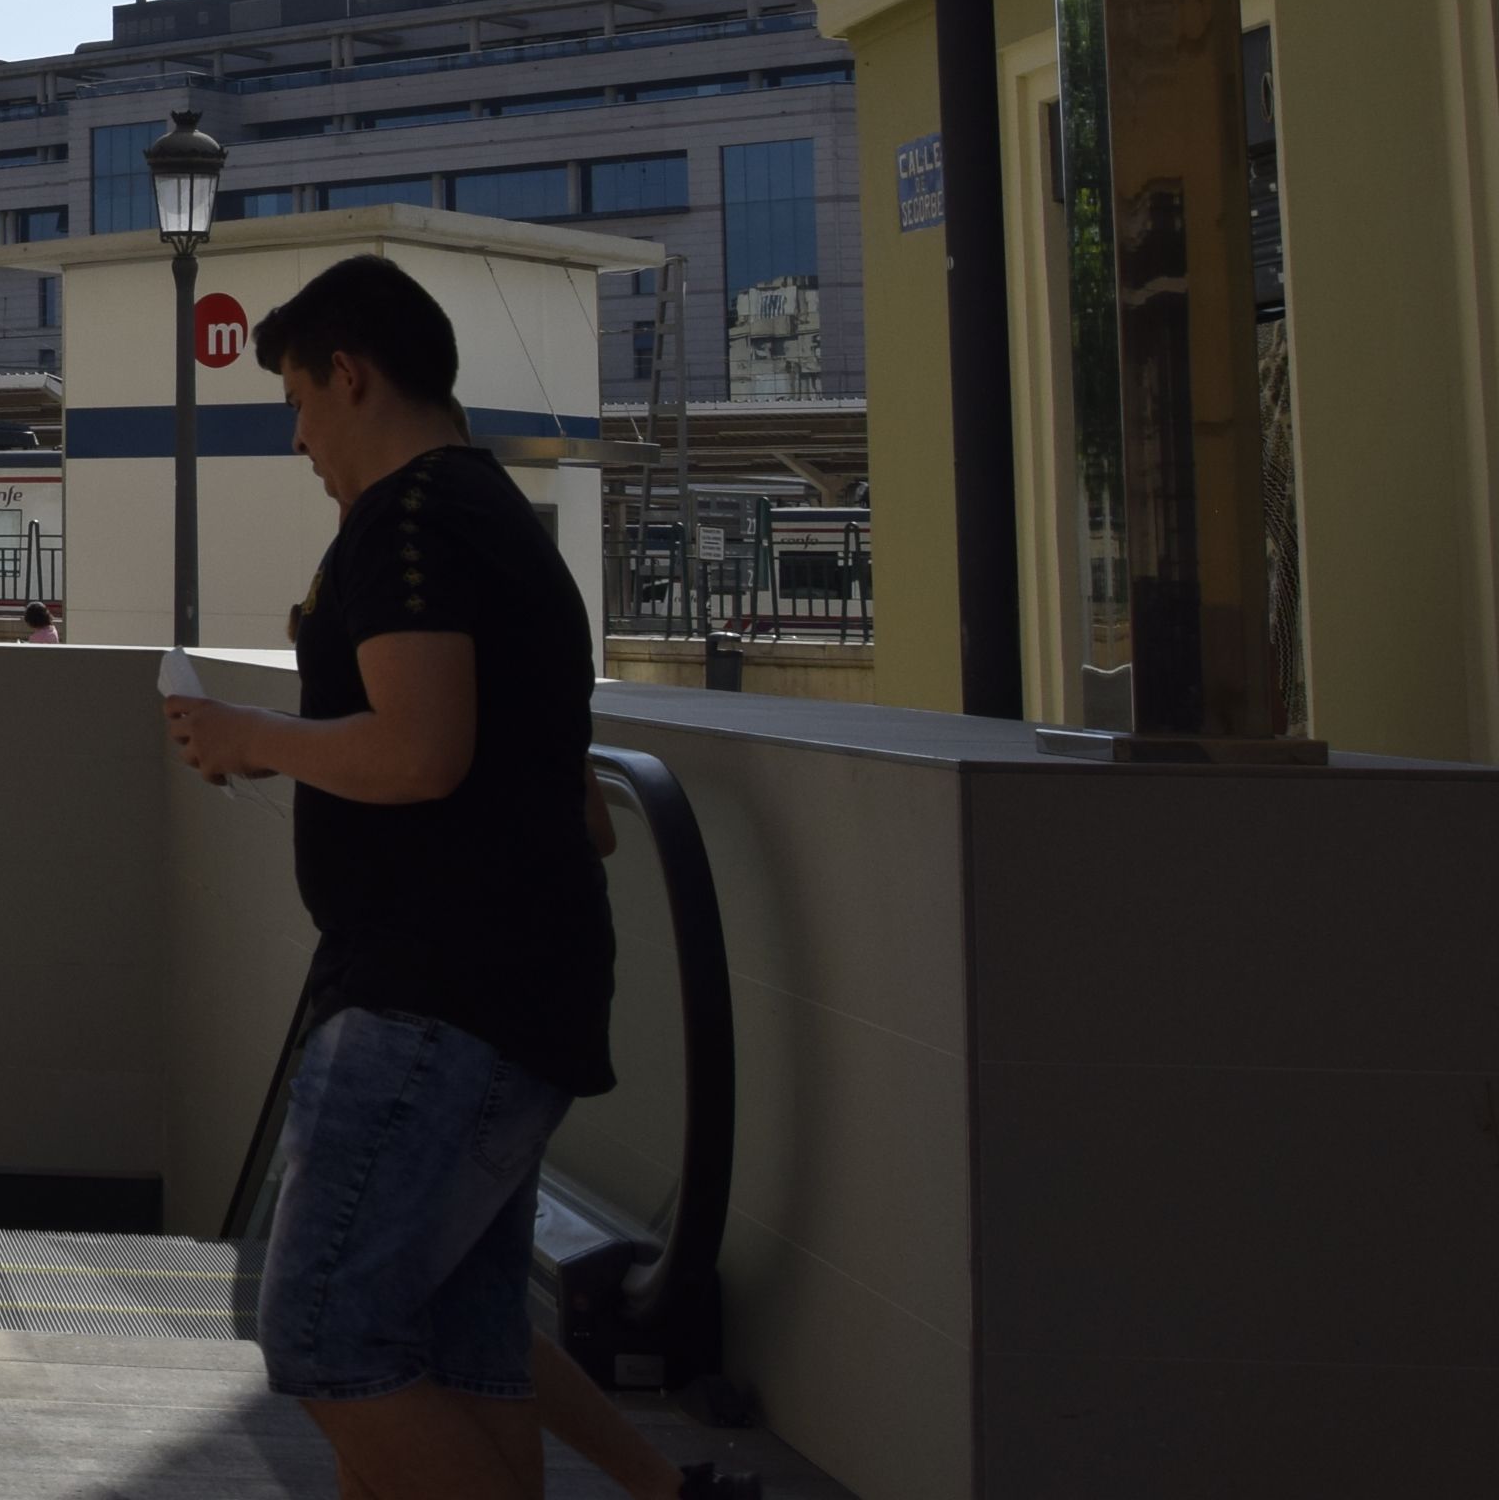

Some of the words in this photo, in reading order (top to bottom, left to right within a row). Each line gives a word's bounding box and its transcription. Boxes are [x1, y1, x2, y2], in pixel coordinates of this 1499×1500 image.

[899, 142, 942, 179] CALLE
[915, 175, 926, 193] DE
[206, 319, 245, 356] m
